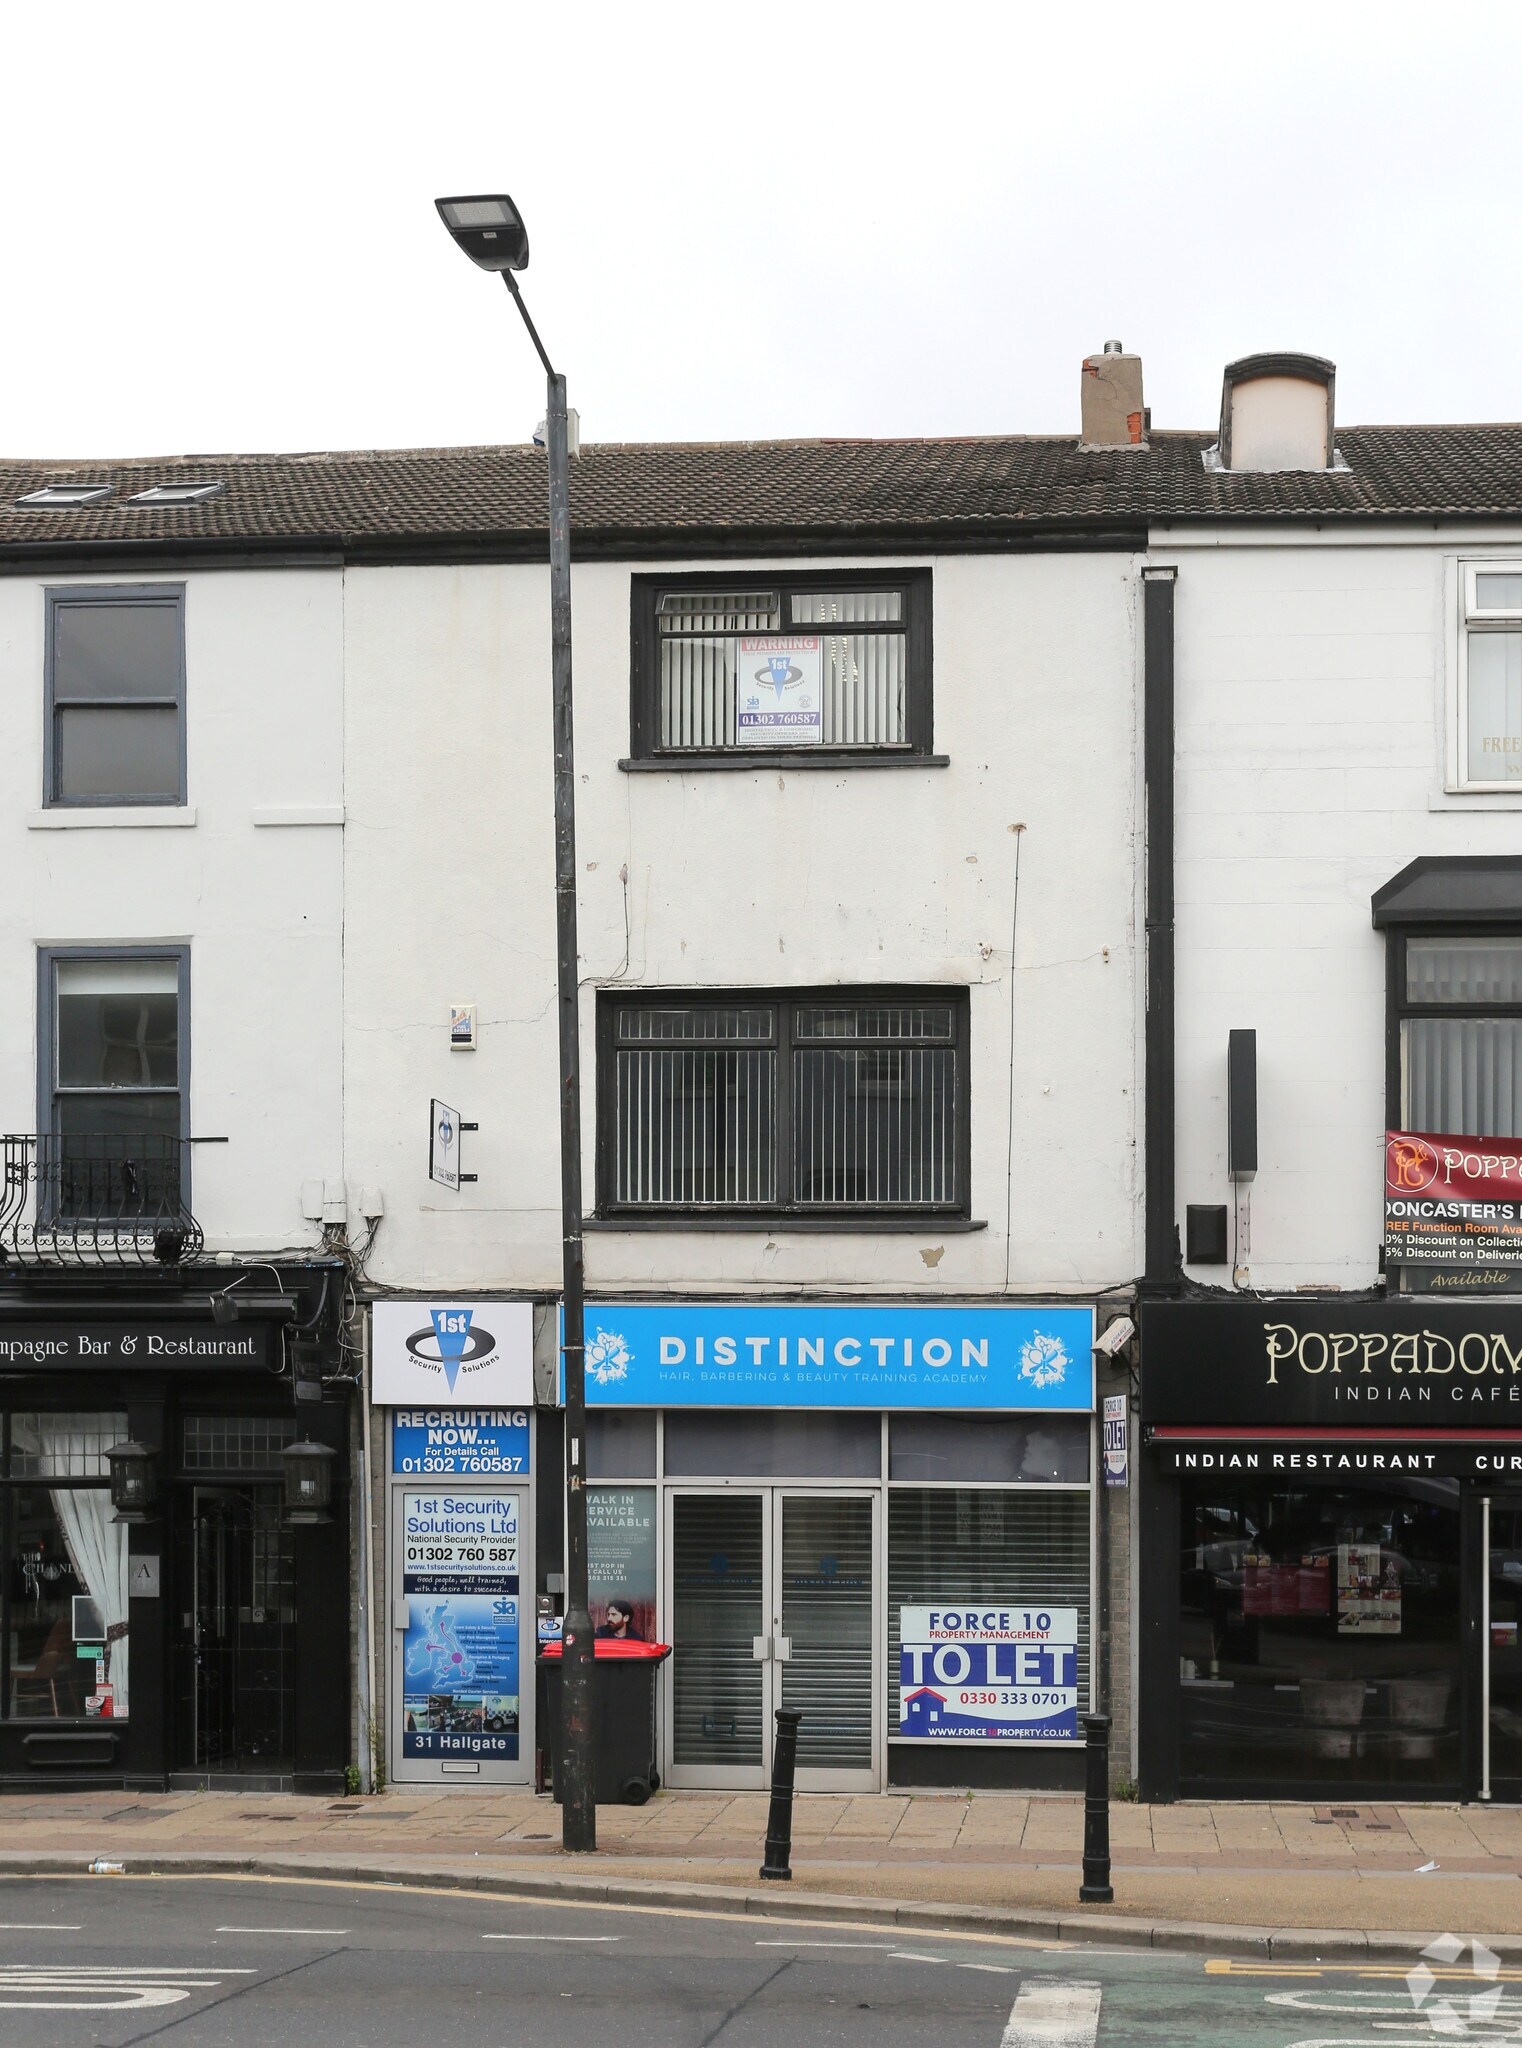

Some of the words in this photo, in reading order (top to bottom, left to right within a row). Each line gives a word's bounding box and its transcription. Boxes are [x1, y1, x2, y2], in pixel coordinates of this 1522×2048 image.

[745, 638, 814, 650] WARNING
[772, 659, 787, 670] 1st
[742, 714, 774, 725] 01302
[778, 713, 816, 724] 760587
[1443, 1148, 1522, 1184] POPP
[1412, 1222, 1462, 1233] Function
[1465, 1224, 1499, 1233] Room
[1406, 1234, 1457, 1246] Discount
[1459, 1237, 1474, 1246] on
[1406, 1247, 1457, 1258] Discount
[1459, 1250, 1474, 1259] on
[1431, 1270, 1510, 1287] Available
[437, 1311, 467, 1333] 1st
[78, 1336, 111, 1354] Bar
[120, 1336, 138, 1354] &
[147, 1336, 256, 1354] Restaurant
[659, 1337, 988, 1367] DISTINCTION
[408, 1355, 442, 1373] Security
[461, 1354, 500, 1373] Solutions
[701, 1372, 777, 1382] BARBERING
[783, 1373, 790, 1381] &
[797, 1373, 848, 1382] BEAUTY
[854, 1373, 919, 1382] TRAINING
[923, 1373, 987, 1383] ACADEMY
[1335, 1387, 1431, 1400] INDIAN
[1451, 1385, 1520, 1401] CAFÉ
[397, 1411, 527, 1427] RECRUITING
[428, 1429, 496, 1445] NOW...
[1113, 1421, 1125, 1449] LET
[425, 1448, 441, 1456] For
[444, 1447, 477, 1456] Details
[480, 1447, 499, 1456] Call
[402, 1457, 455, 1472] 01302
[460, 1457, 522, 1472] 760587
[1175, 1454, 1259, 1467] INDIAN
[1273, 1455, 1436, 1468] RESTAURANT
[621, 1496, 634, 1504] IN
[414, 1499, 438, 1514] 1st
[443, 1498, 511, 1518] Security
[407, 1517, 485, 1533] Solutions
[491, 1518, 516, 1533] Ltd
[407, 1535, 442, 1543] National
[444, 1535, 478, 1545] Security
[481, 1536, 516, 1544] Provider
[408, 1547, 453, 1560] 01302
[457, 1548, 485, 1561] 760
[489, 1548, 516, 1561] 587
[407, 1563, 516, 1571] www.1stsecuritysolutions.co.uk
[434, 1576, 458, 1585] people,
[493, 1596, 515, 1614] sia
[929, 1612, 1010, 1630] FORCE
[1023, 1613, 1051, 1631] 10
[929, 1631, 976, 1639] PROPERTY
[980, 1631, 1050, 1639] MANAGEMENT
[903, 1644, 971, 1685] TO
[986, 1645, 1074, 1685] LET
[960, 1692, 997, 1704] 0330
[1001, 1693, 1028, 1705] 333
[1032, 1693, 1067, 1705] 0701
[928, 1728, 1072, 1737] WWW.FORCE10PROPERTY.CO.UK
[415, 1736, 433, 1749] 31
[440, 1736, 506, 1751] Hallgate
